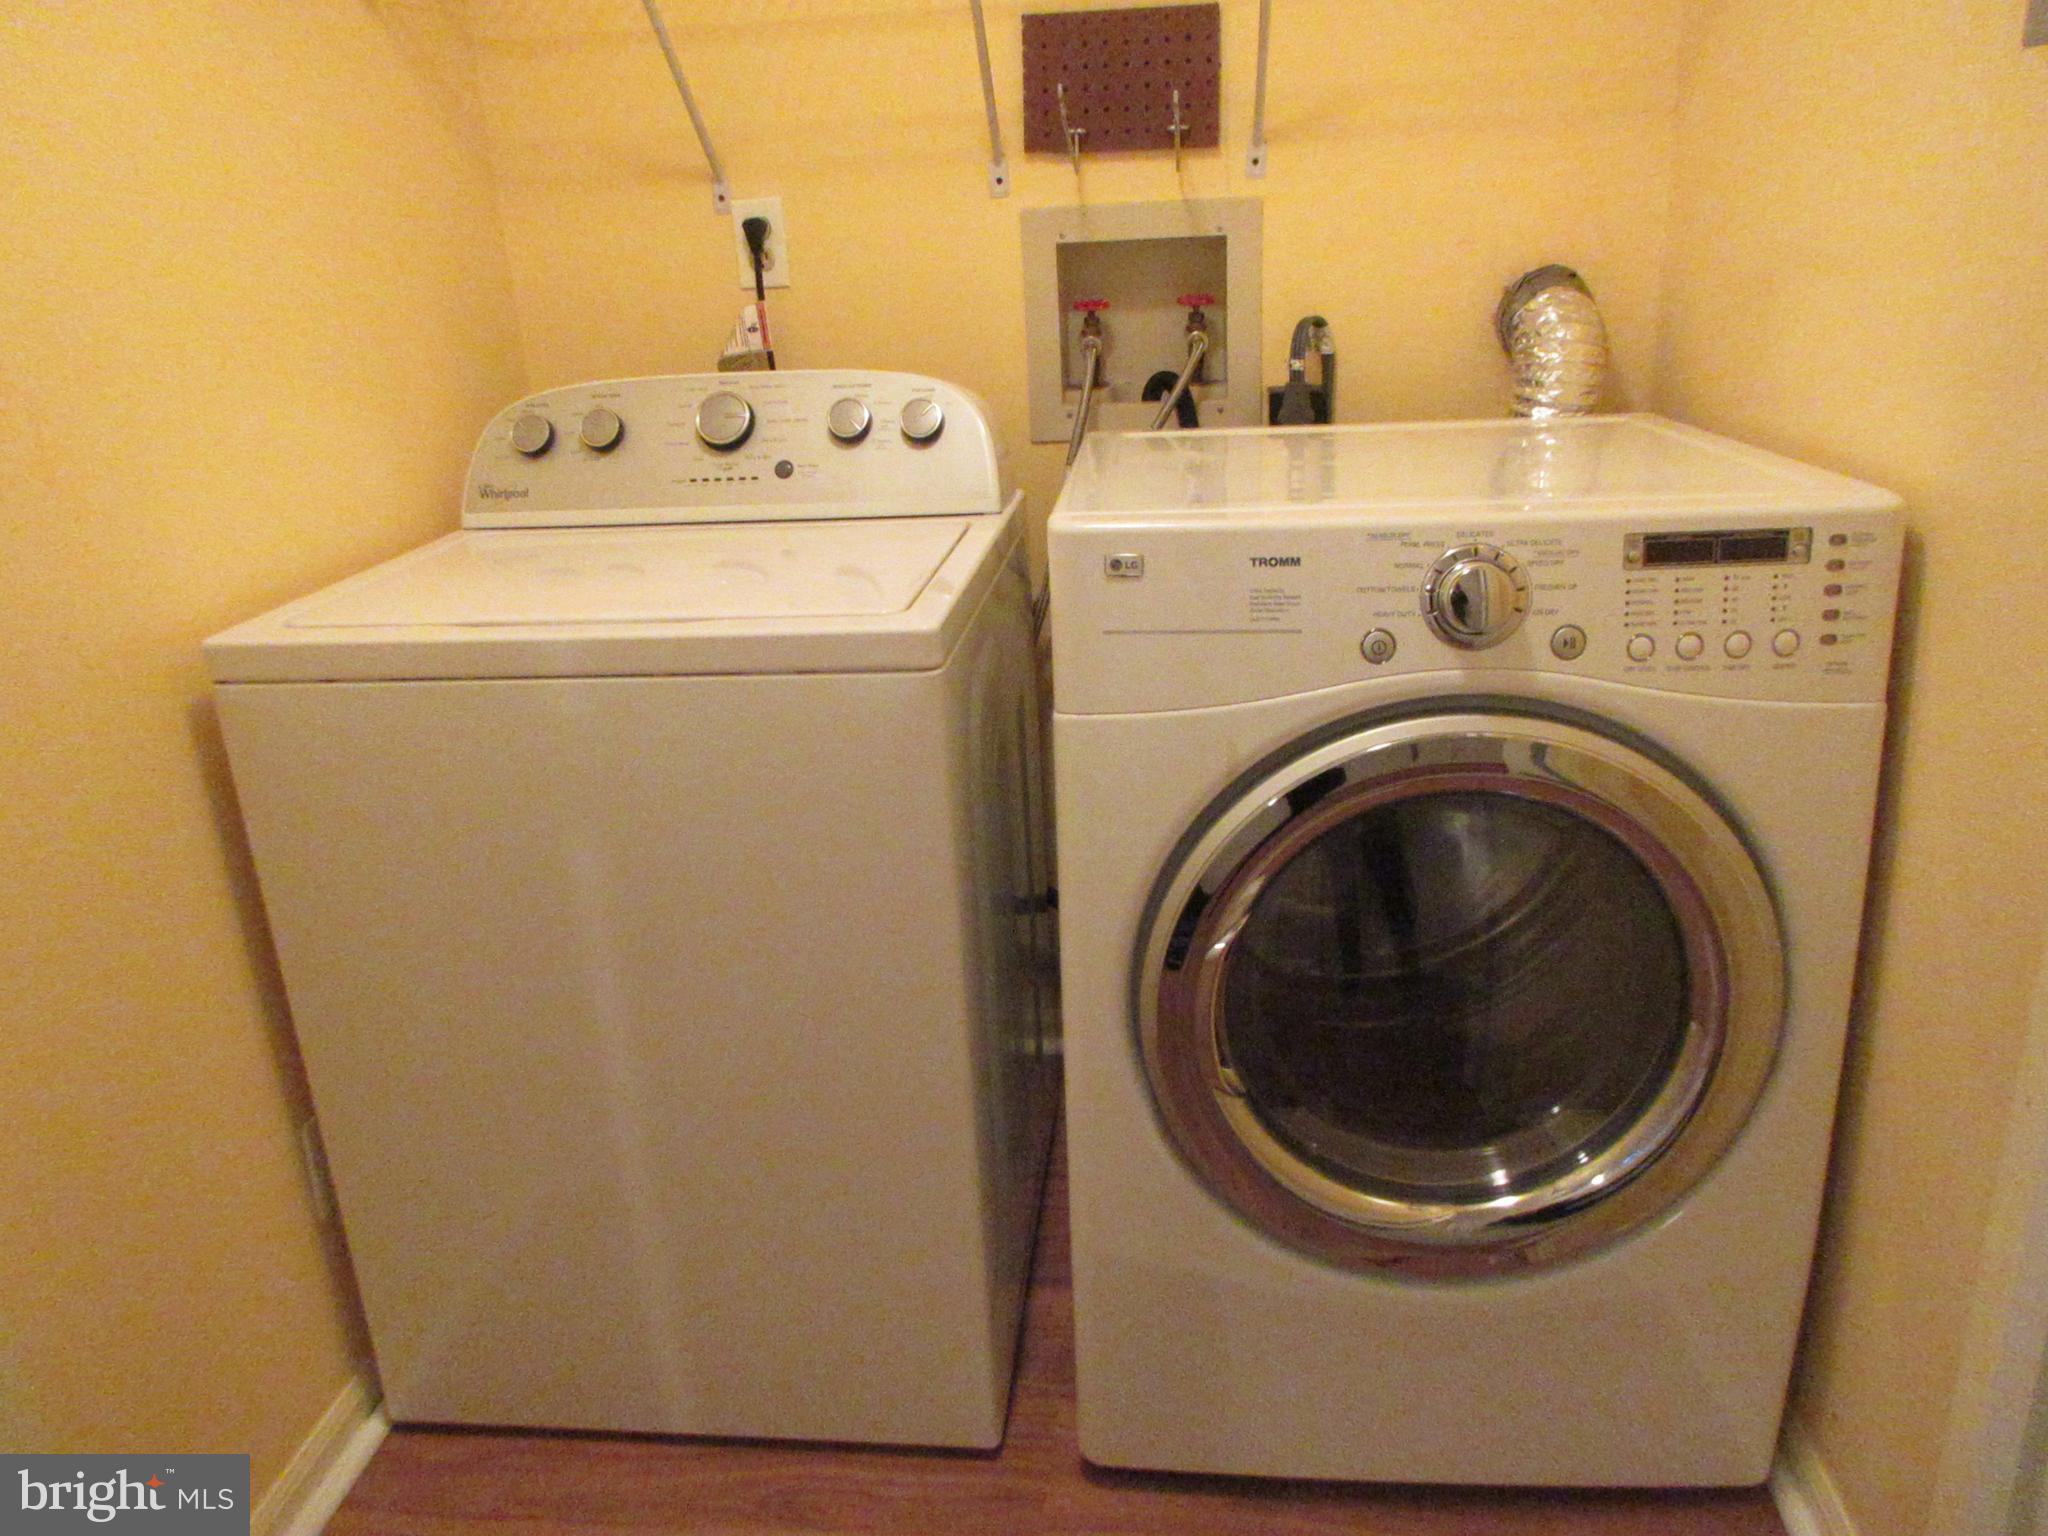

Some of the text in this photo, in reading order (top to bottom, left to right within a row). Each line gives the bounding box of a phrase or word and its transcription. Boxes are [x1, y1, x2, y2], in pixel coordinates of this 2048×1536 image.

[478, 484, 529, 501] Whirlpool
[1124, 561, 1138, 570] LG
[1250, 556, 1302, 568] TROMM
